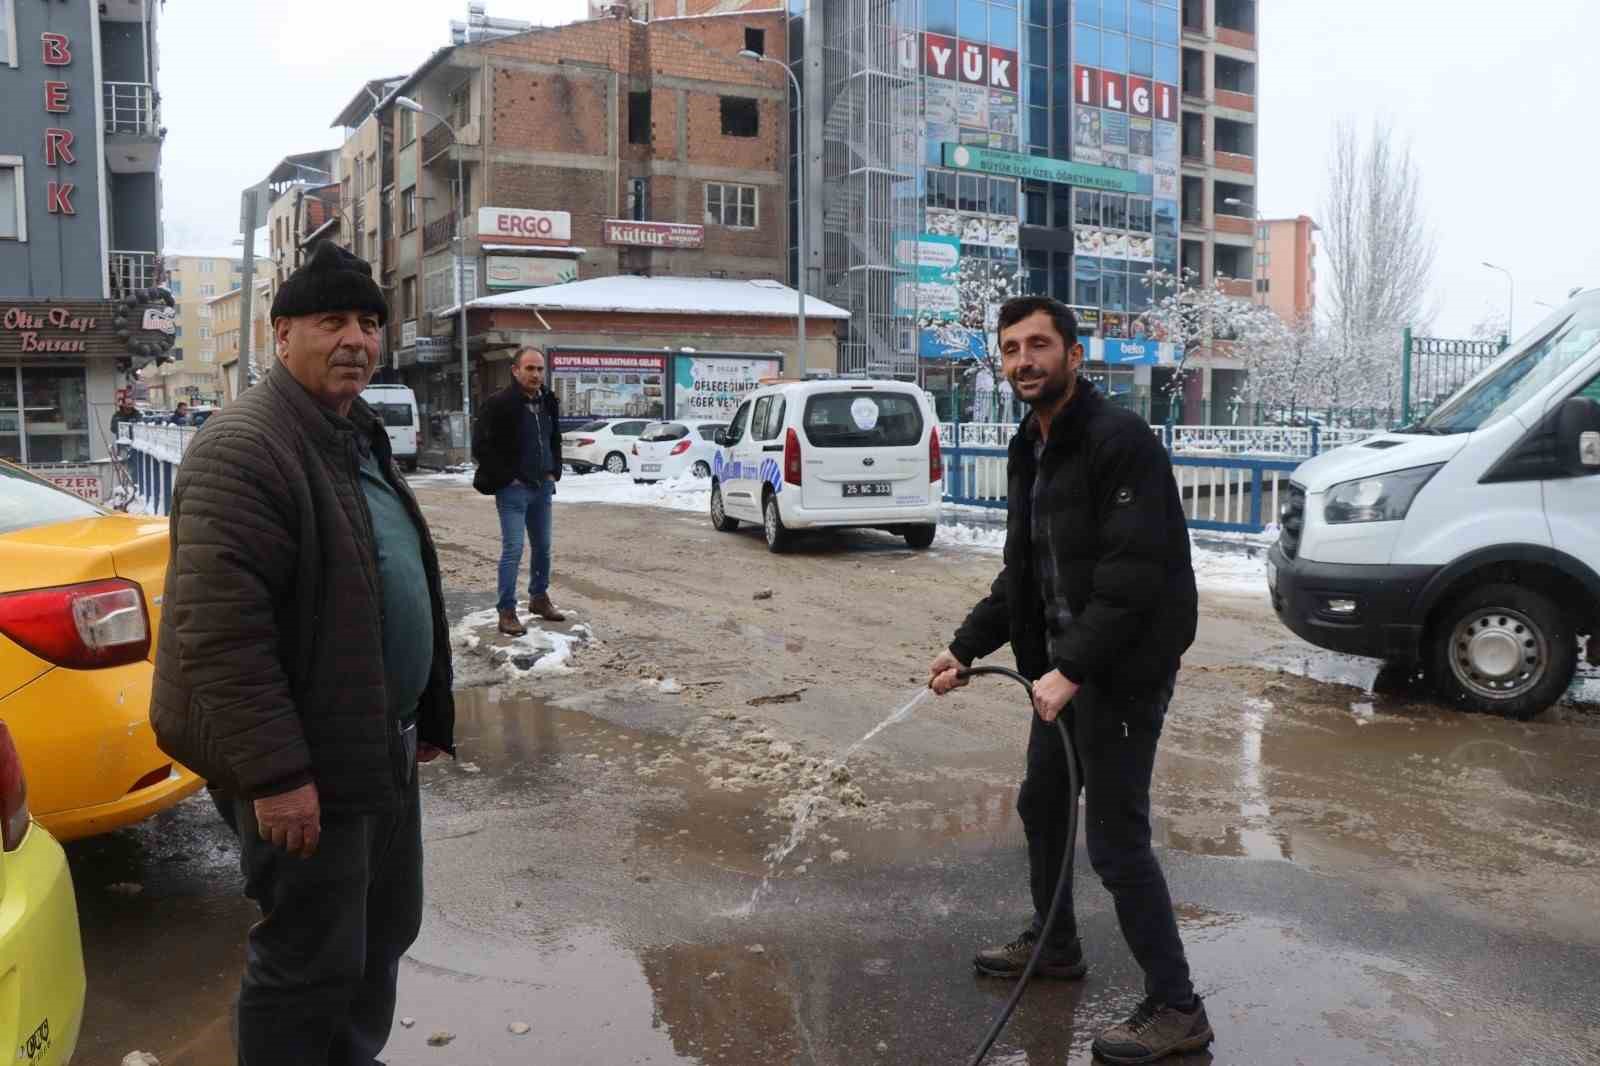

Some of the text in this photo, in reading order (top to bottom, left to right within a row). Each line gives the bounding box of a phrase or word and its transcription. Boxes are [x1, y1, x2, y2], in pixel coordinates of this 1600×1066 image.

[1082, 69, 1169, 119] İLGİ
[41, 32, 75, 215] BERK
[496, 214, 552, 235] ERGO
[610, 225, 665, 246] Kültür
[1120, 342, 1145, 354] beko
